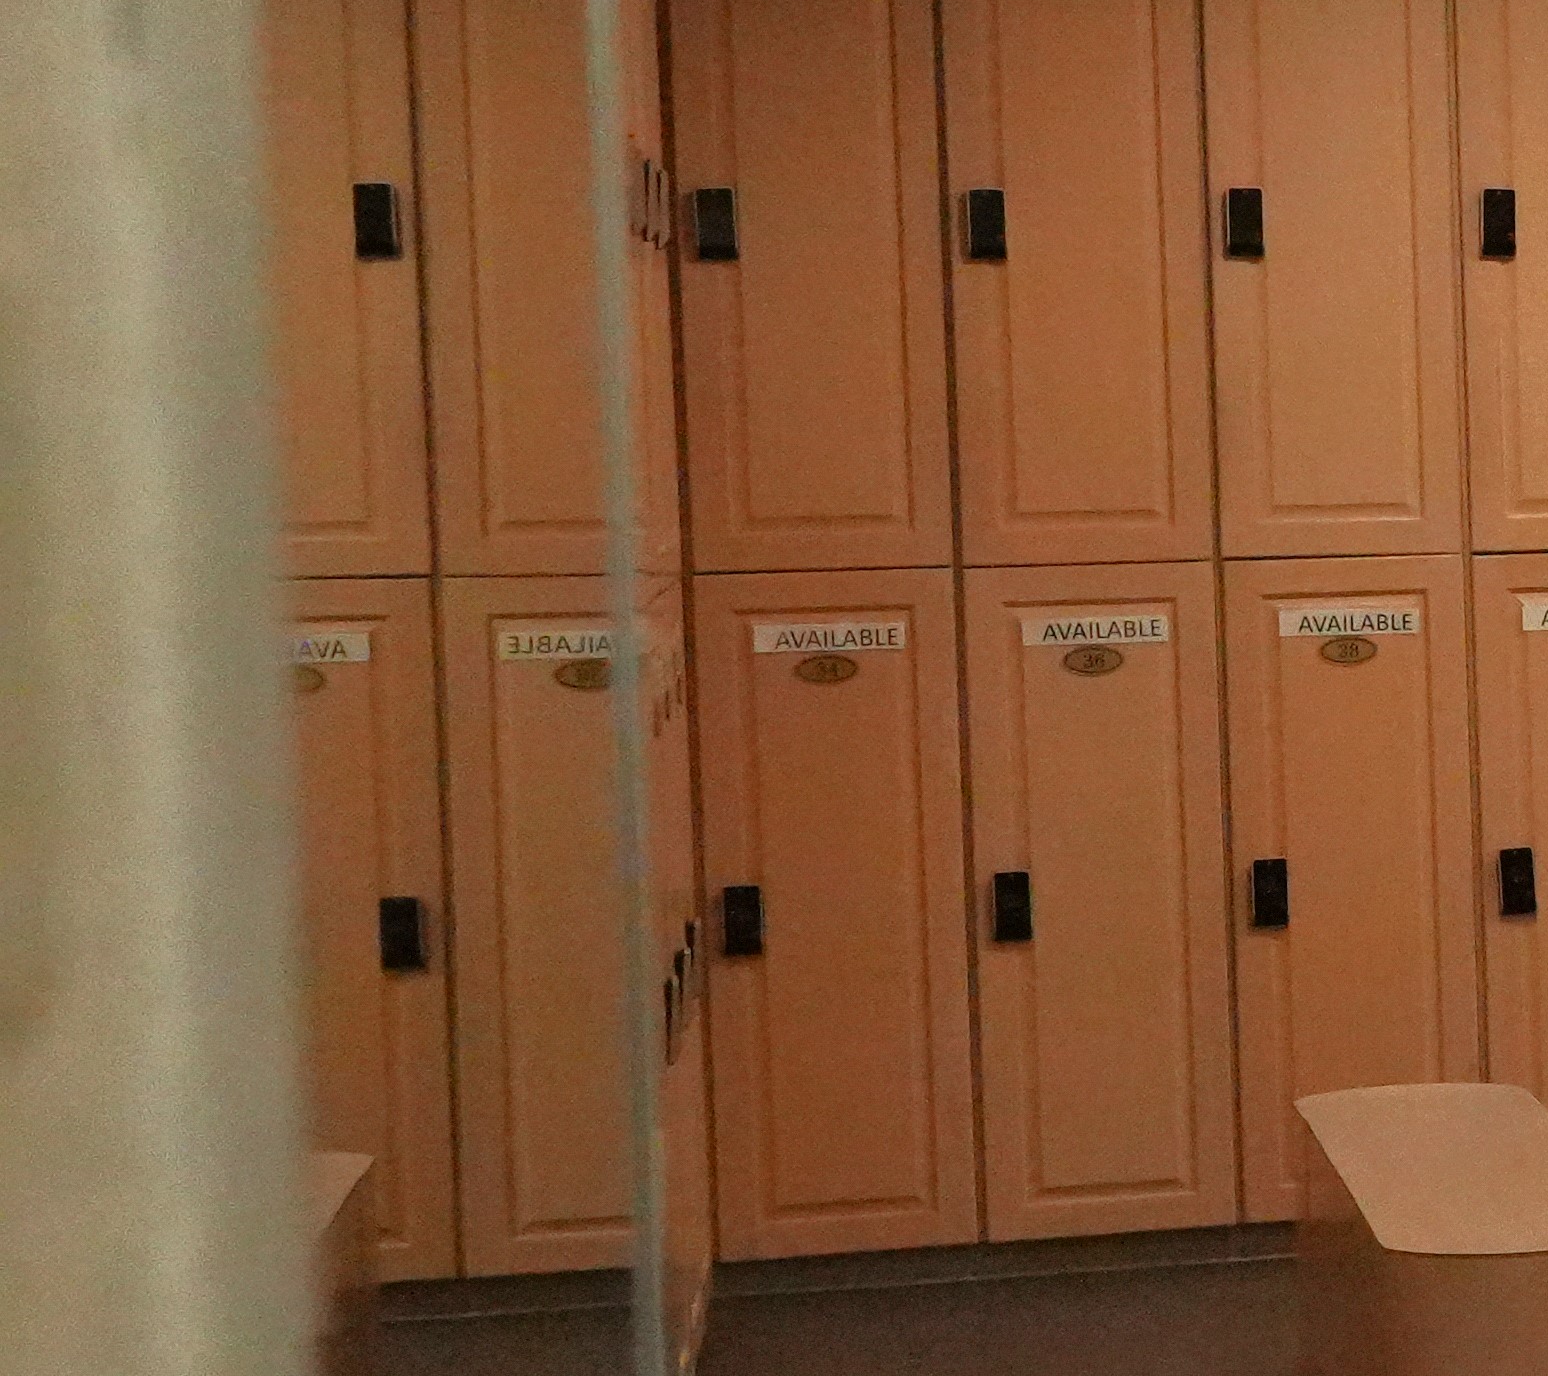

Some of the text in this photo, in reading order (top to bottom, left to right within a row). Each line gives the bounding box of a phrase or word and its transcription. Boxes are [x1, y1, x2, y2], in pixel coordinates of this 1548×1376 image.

[1042, 618, 1161, 642] AVAILABLE
[1298, 613, 1414, 634] AVAILABLE
[774, 628, 900, 650] AVAILABLE
